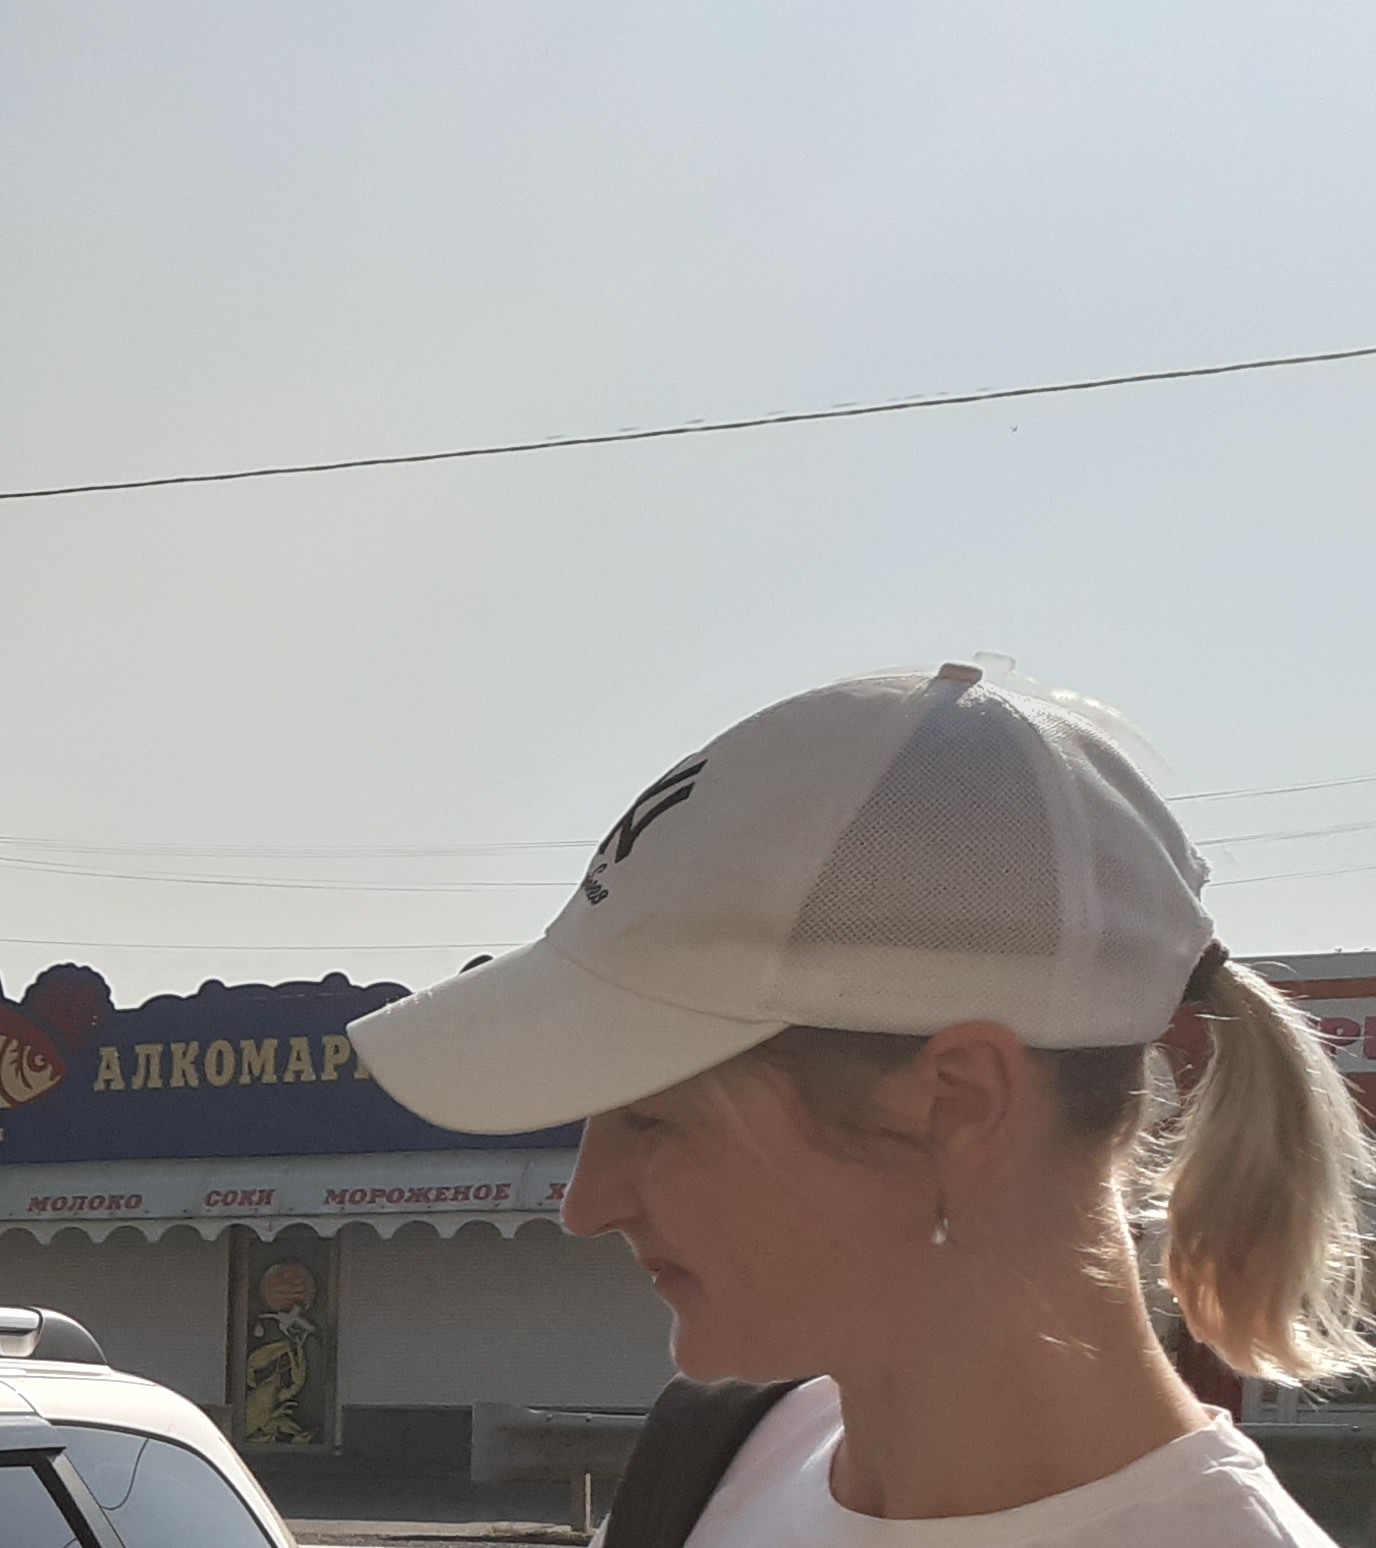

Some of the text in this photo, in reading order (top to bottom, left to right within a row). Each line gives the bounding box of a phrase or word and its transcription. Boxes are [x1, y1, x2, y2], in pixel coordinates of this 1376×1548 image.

[27, 1194, 143, 1212] МОЛОКО
[204, 1189, 276, 1208] СОКИ
[324, 1183, 512, 1205] МОРОЖЕНОЕ
